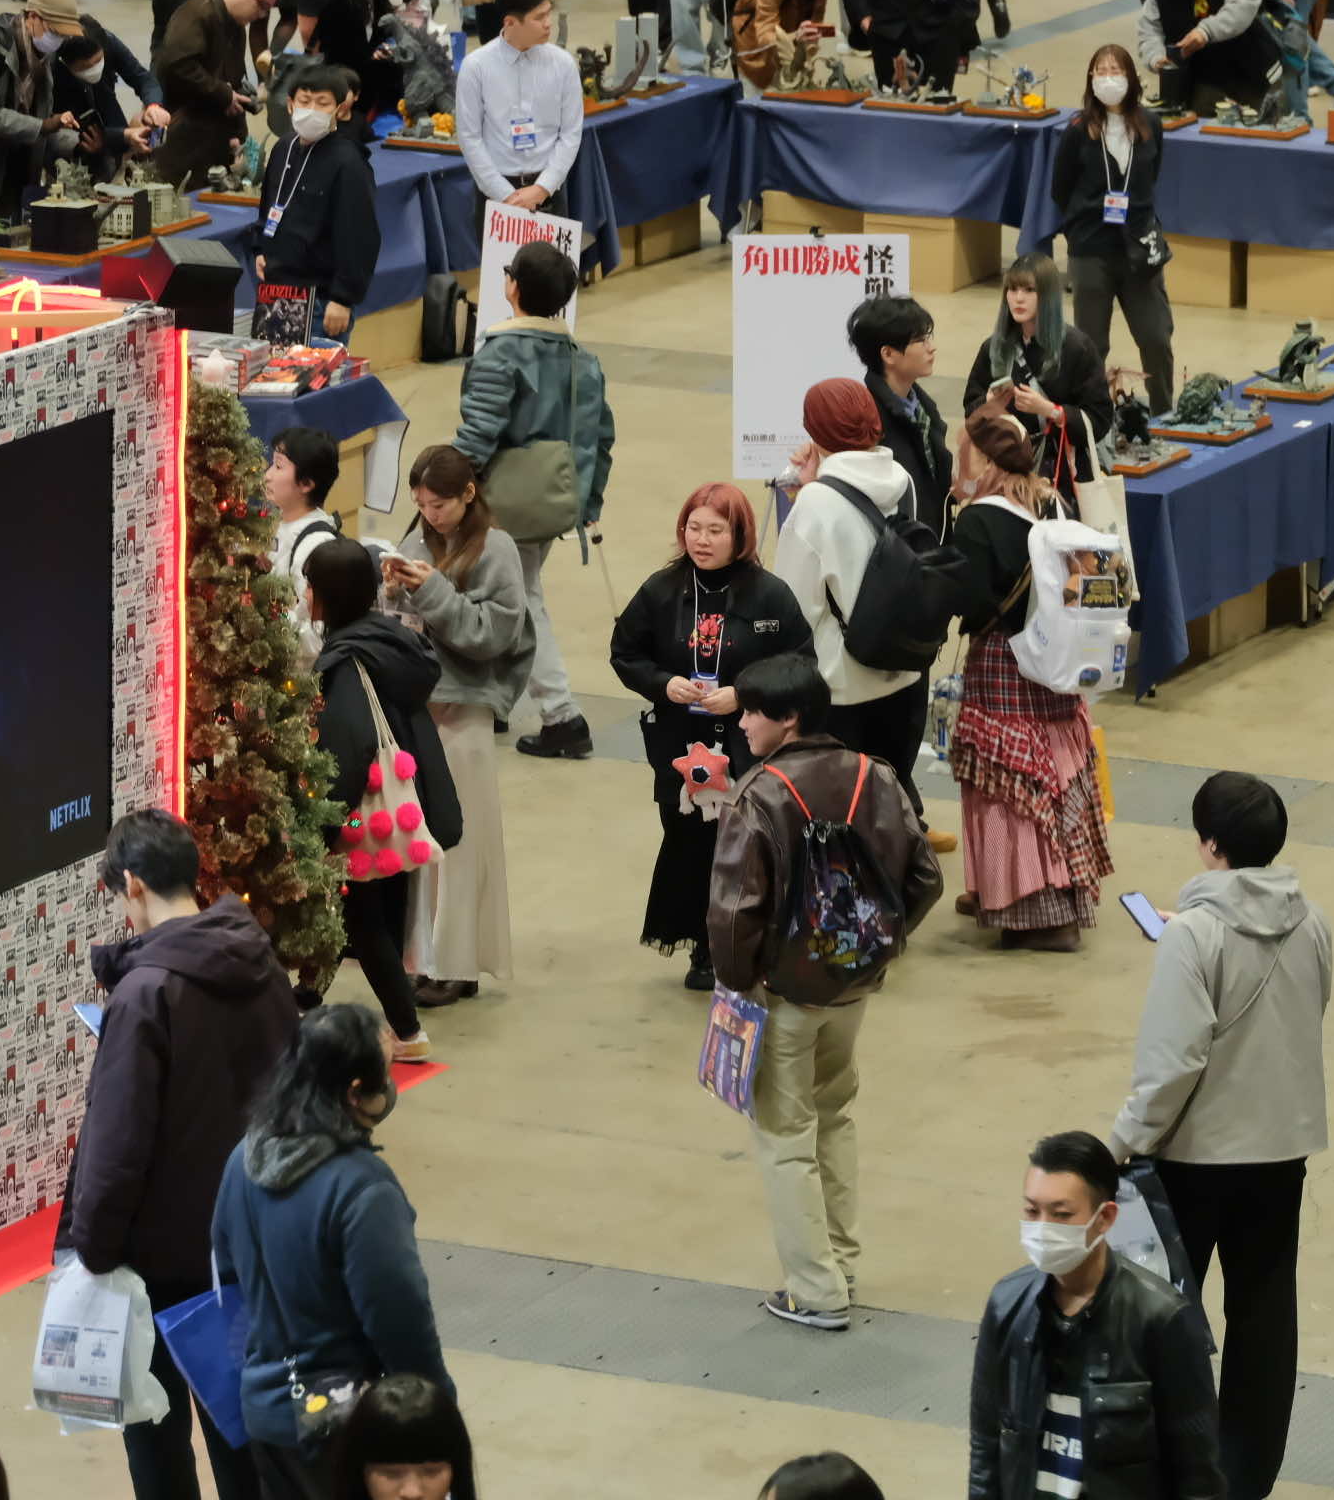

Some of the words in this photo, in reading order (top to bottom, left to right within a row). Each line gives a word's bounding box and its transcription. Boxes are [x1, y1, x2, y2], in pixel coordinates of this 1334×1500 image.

[489, 209, 556, 244] 角田勝成
[741, 243, 861, 277] 角田勝成
[258, 283, 308, 304] GODZILLA
[49, 794, 91, 832] NETFLIX
